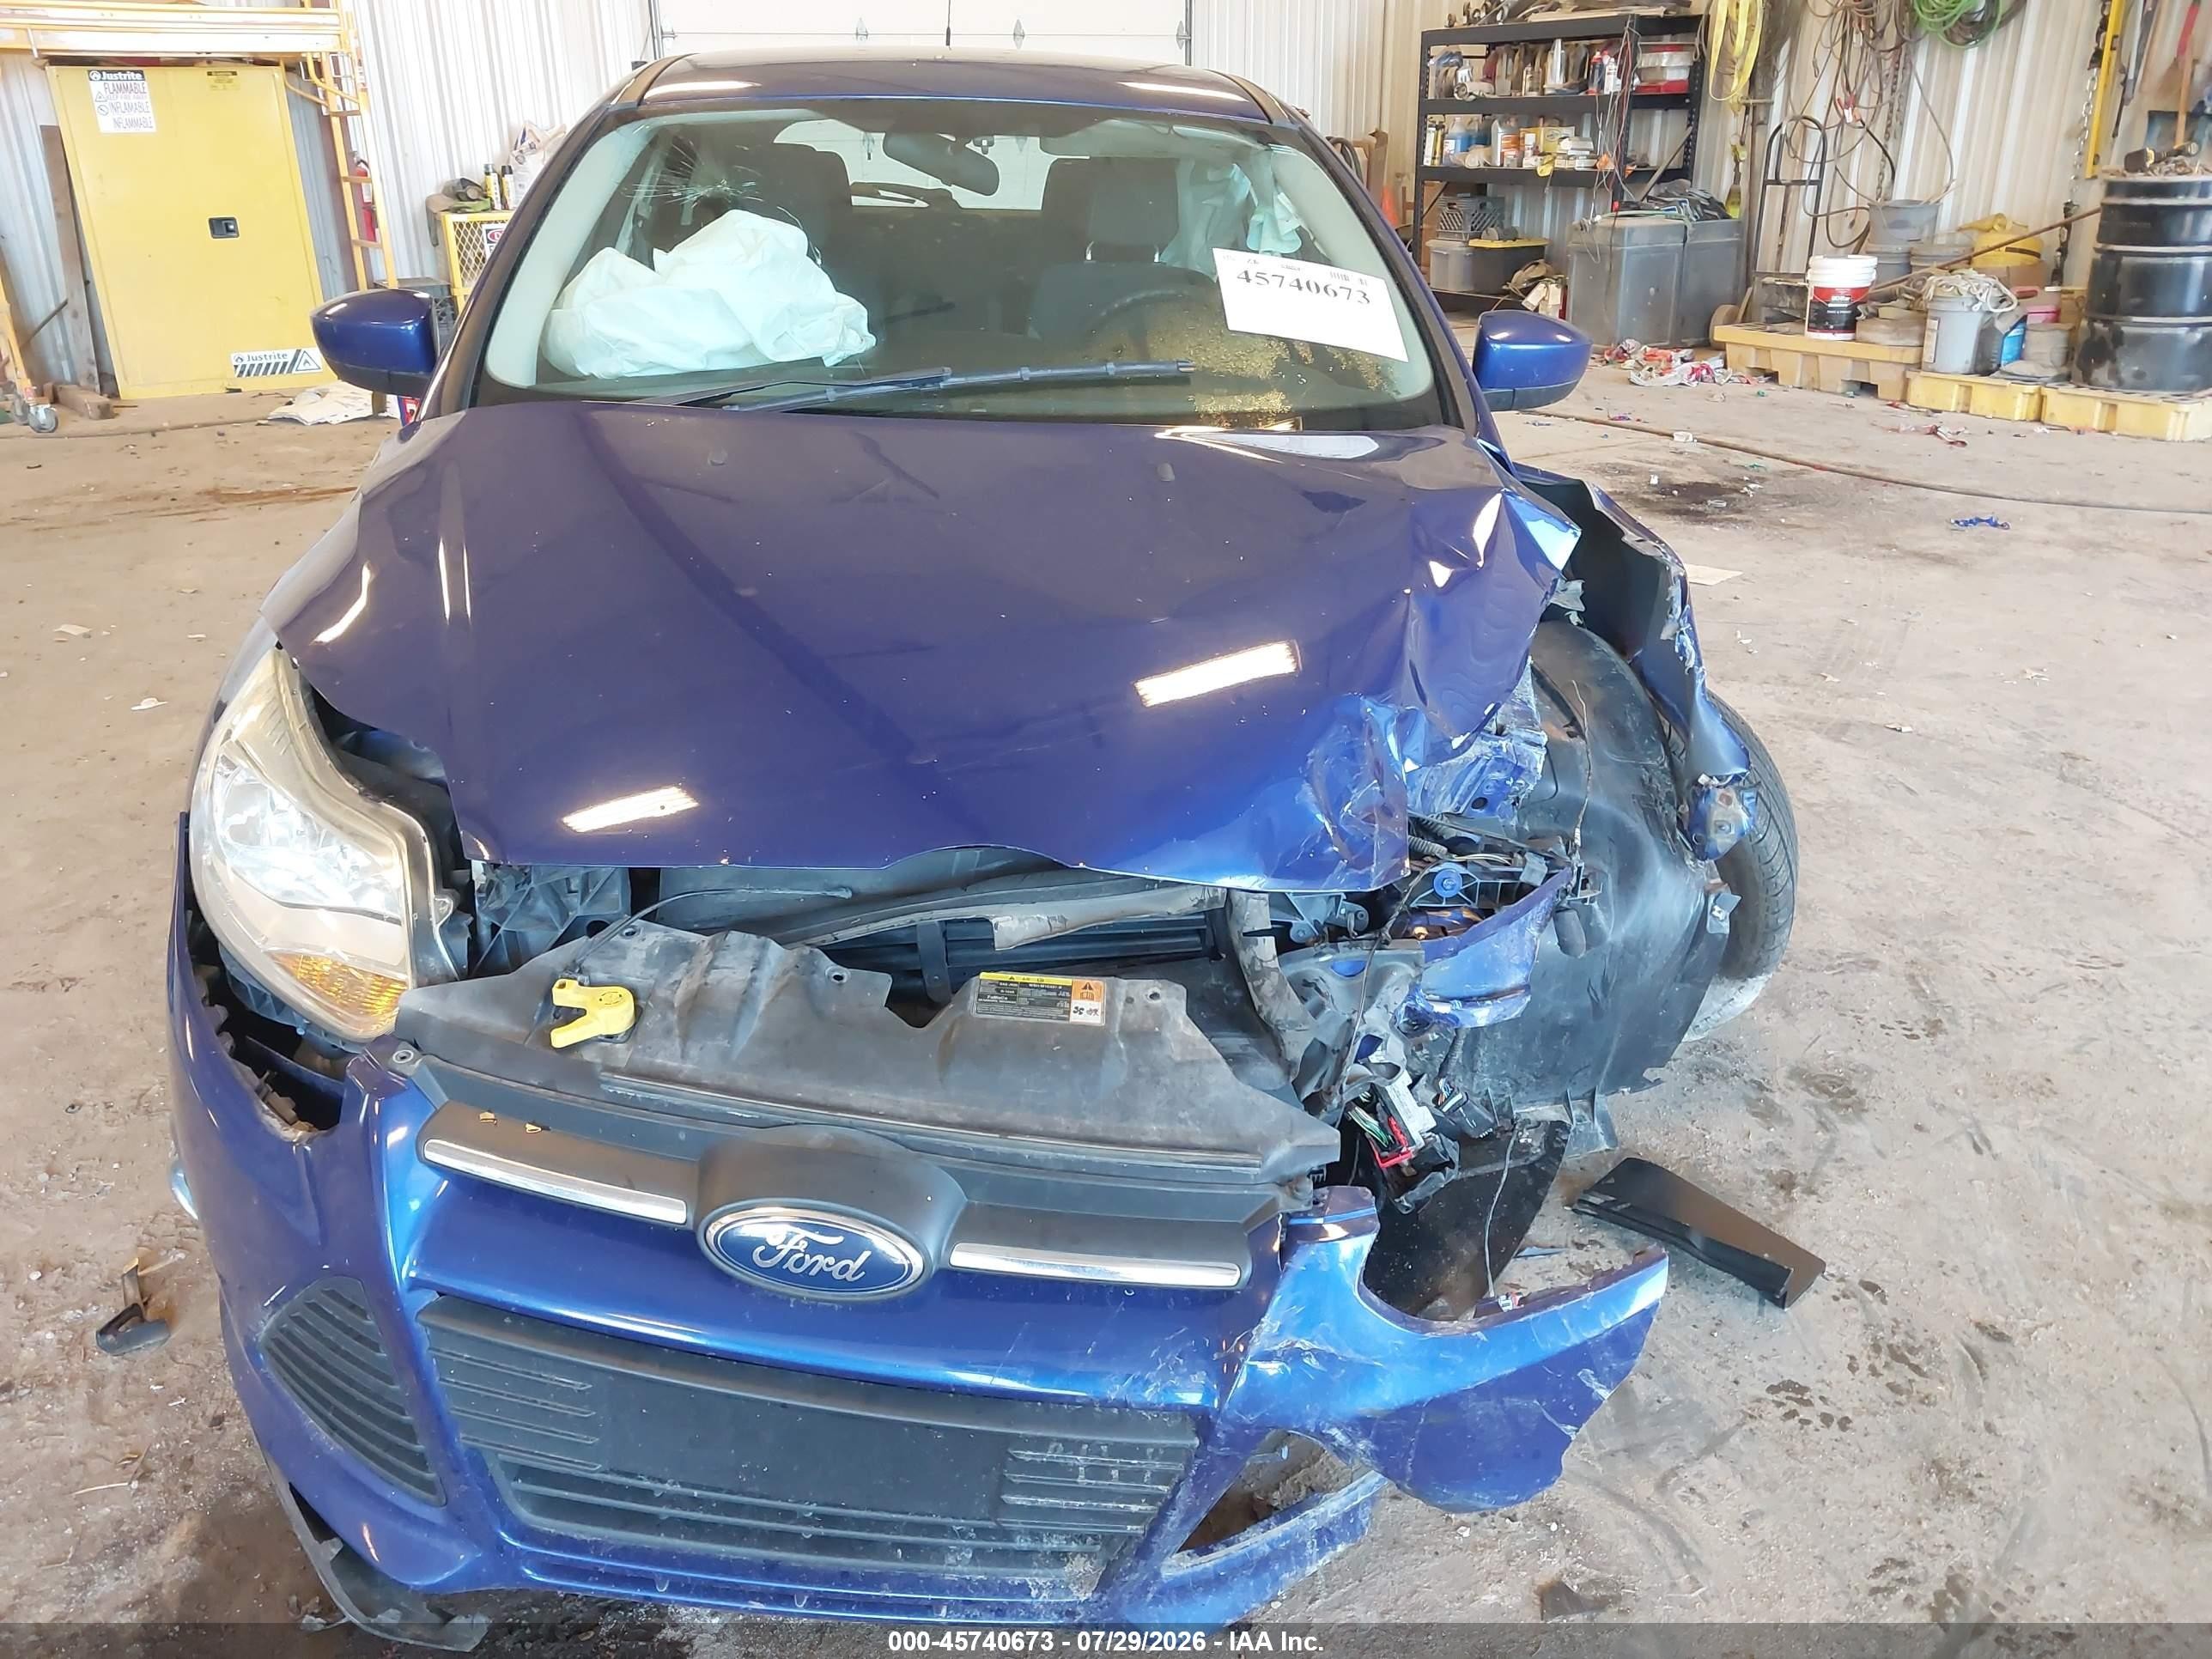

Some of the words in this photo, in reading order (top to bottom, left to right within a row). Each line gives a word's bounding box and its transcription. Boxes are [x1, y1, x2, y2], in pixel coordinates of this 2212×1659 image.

[101, 70, 143, 81] Justrite
[103, 82, 148, 94] FLAMMABLE
[1236, 269, 1370, 305] 45740673
[246, 350, 289, 362] Justrite
[752, 1223, 872, 1283] Ford
